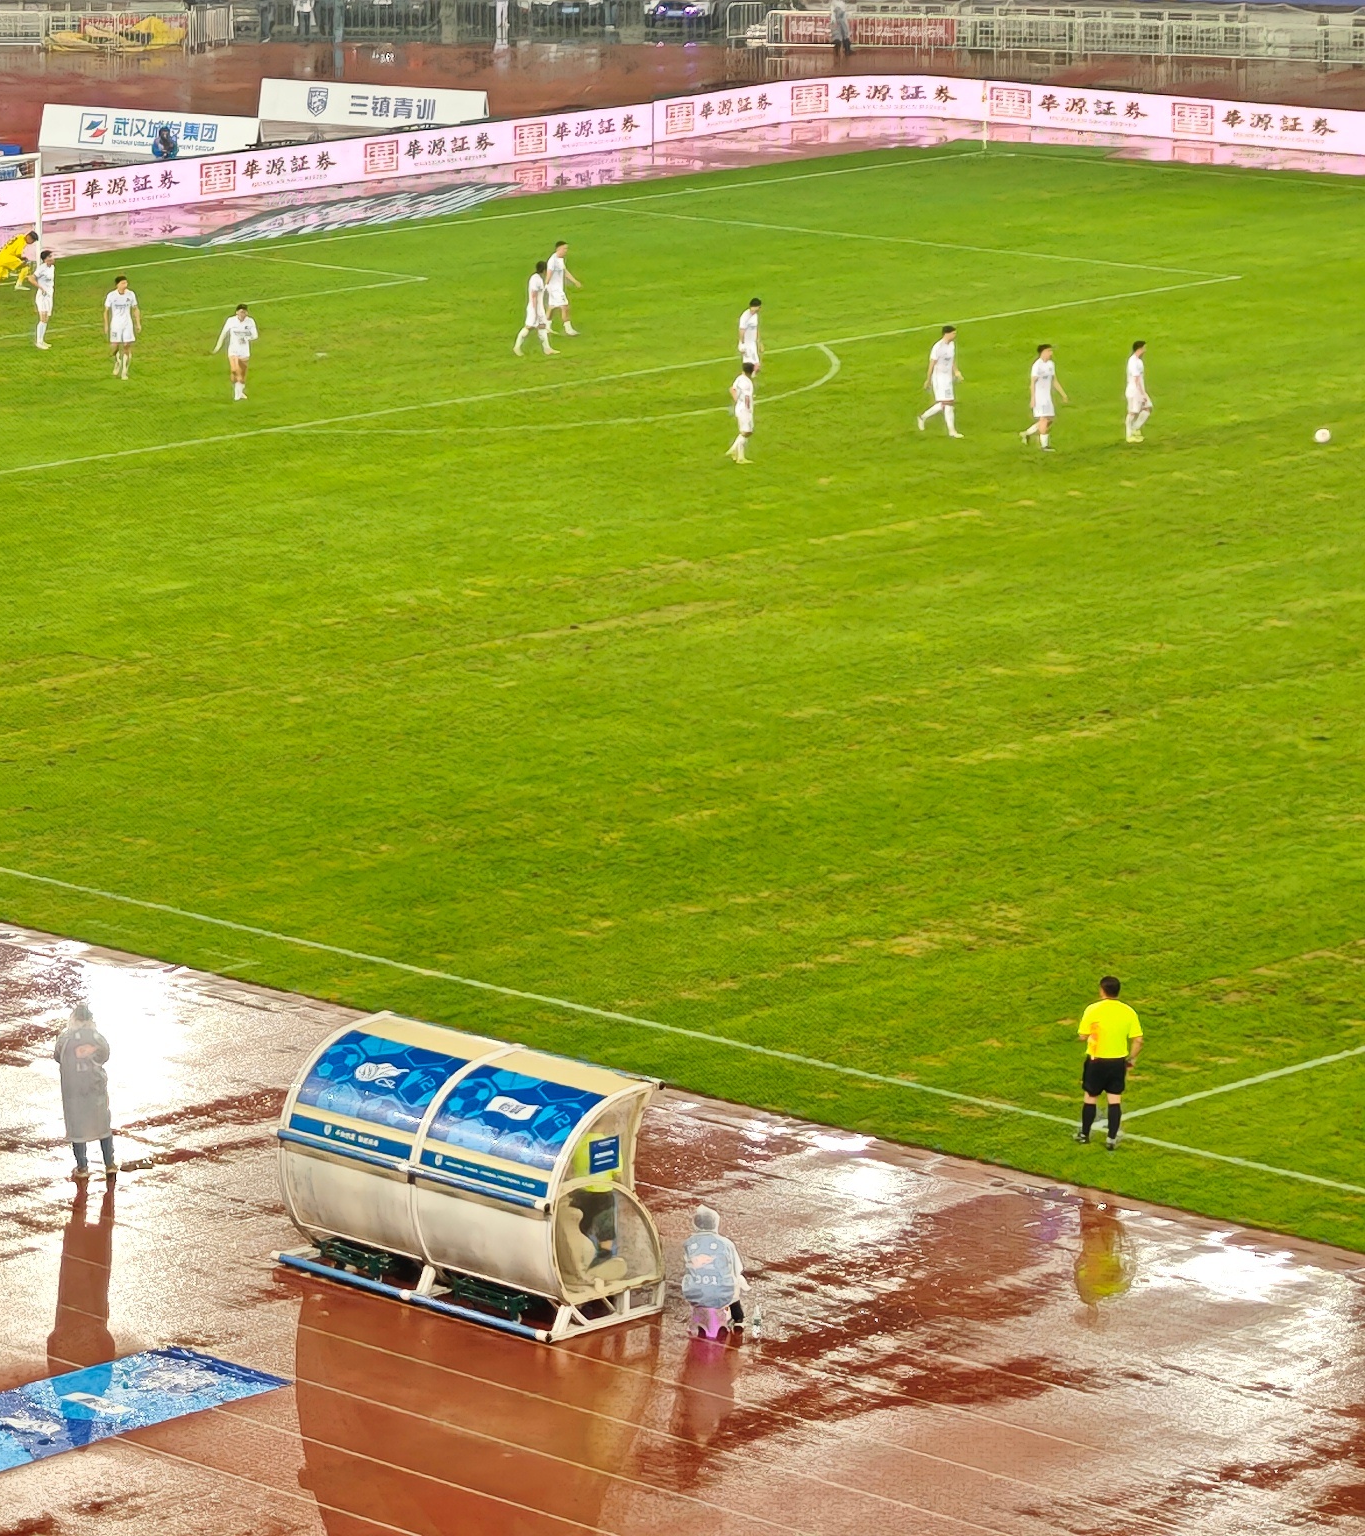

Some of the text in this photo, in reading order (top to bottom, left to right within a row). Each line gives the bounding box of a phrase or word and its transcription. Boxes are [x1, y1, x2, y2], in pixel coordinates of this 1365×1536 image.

[835, 84, 958, 103] 華源証券
[1038, 93, 1149, 119] 華源証券
[349, 94, 437, 120] 三镇青训
[113, 117, 218, 143] 武汉城发集团
[552, 114, 640, 141] 華源証券
[1221, 109, 1338, 136] 華源証券
[404, 132, 495, 160] 華源証券
[242, 153, 337, 180] 華源証券
[81, 173, 181, 199] 華源証券
